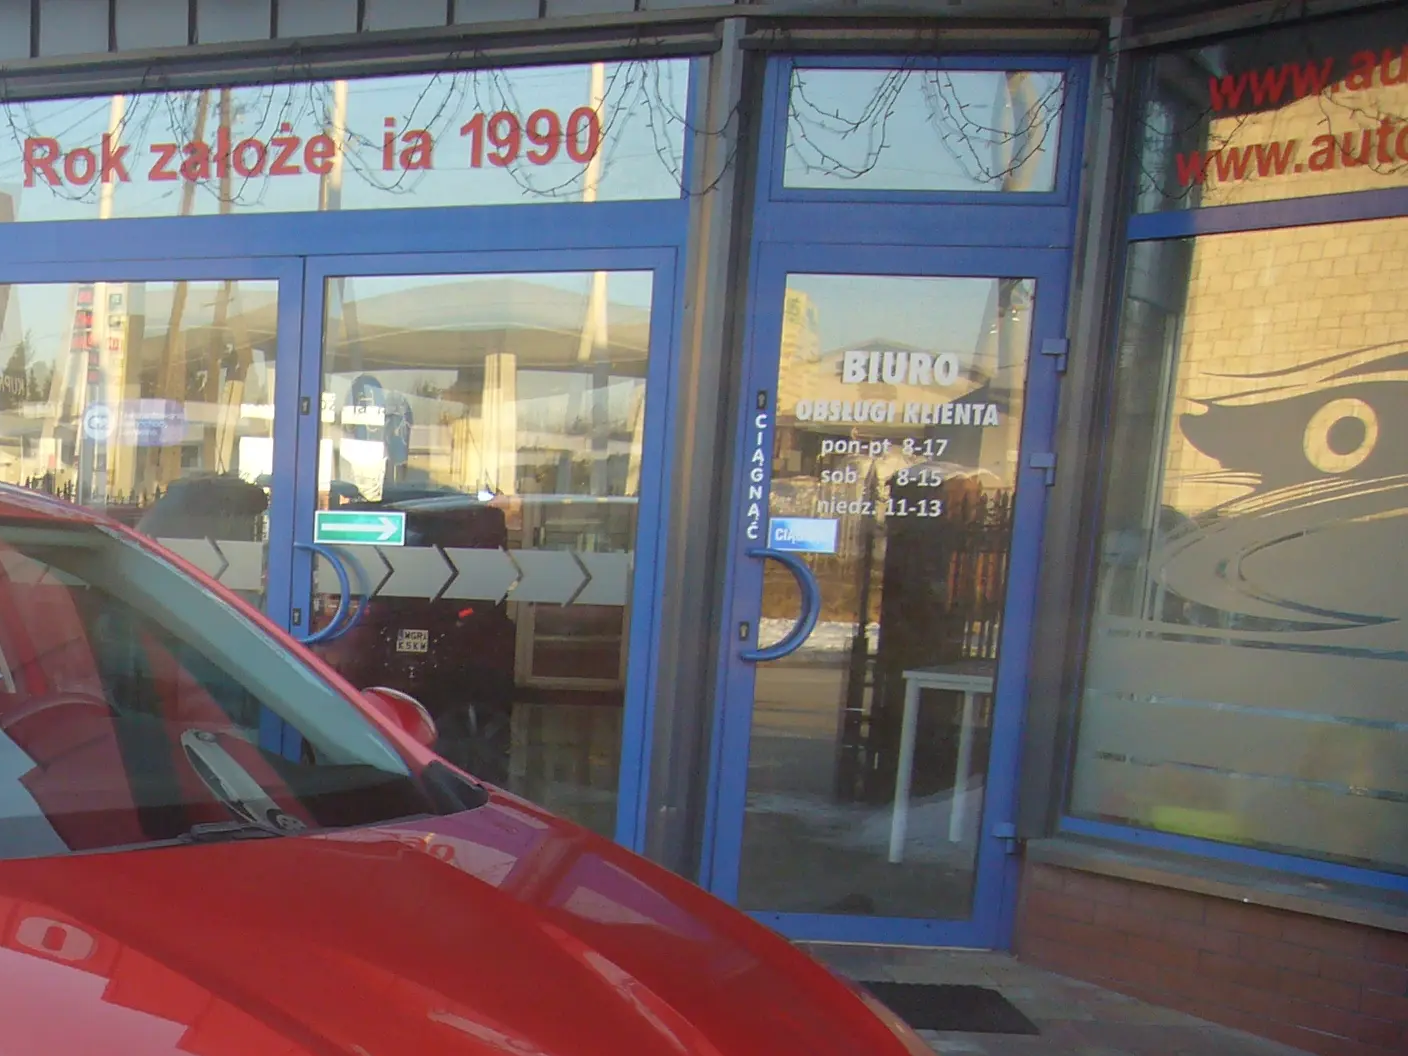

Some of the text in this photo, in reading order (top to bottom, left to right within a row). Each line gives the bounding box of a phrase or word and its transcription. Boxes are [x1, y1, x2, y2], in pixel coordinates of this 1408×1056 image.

[22, 135, 129, 187] Rok
[459, 106, 597, 168] 1990
[842, 351, 959, 386] BIURO
[904, 402, 999, 426] KLIENTA
[821, 438, 948, 458] pon-pt 8-17
[820, 465, 942, 486] sob 8-15
[885, 499, 942, 516] 11-13
